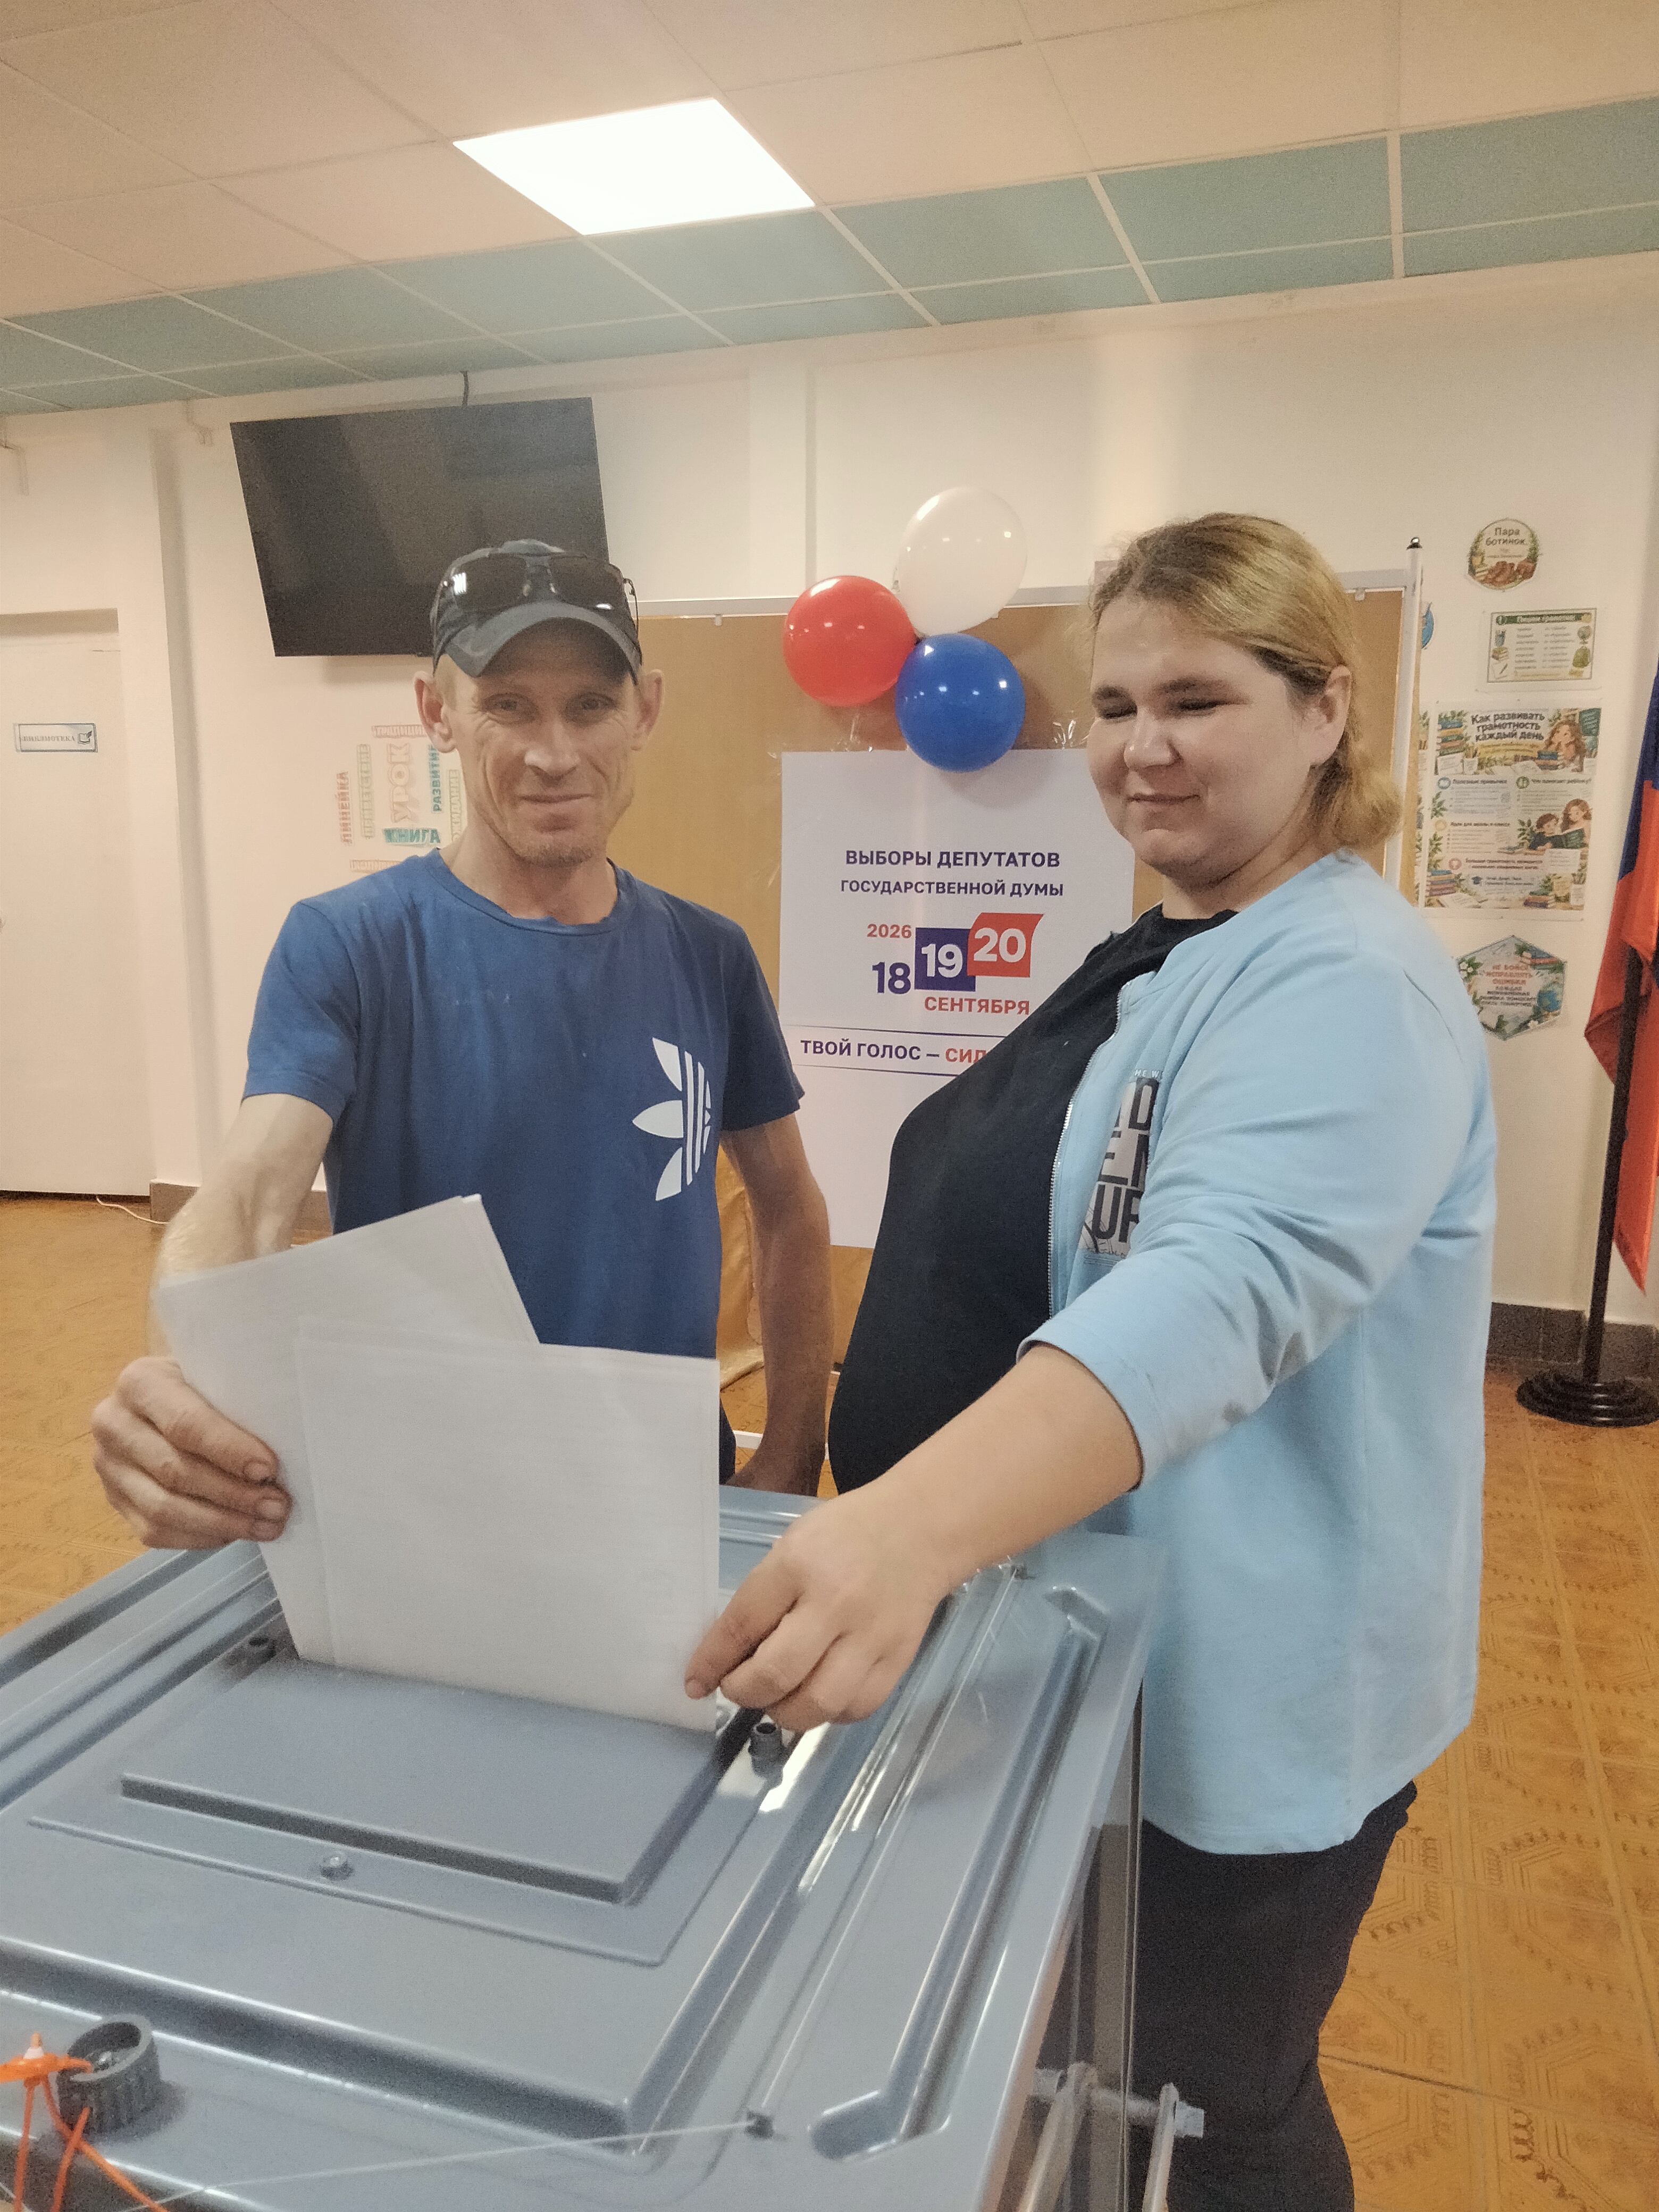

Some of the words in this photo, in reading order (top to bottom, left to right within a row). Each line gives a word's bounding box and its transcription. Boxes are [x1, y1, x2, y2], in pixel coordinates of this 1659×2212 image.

[1495, 527, 1520, 537] Пара
[1471, 715, 1490, 725] Как
[1493, 713, 1545, 722] развивать
[1477, 722, 1541, 732] грамотность
[1476, 731, 1517, 742] каждый
[1519, 732, 1544, 740] день
[387, 743, 412, 823] УРОК
[336, 771, 352, 844] ЛИНЕЙКА
[383, 828, 441, 844] КНИГА
[845, 850, 931, 866] ВЫБОРЫ
[937, 851, 1060, 868] ДЕПУТАТОВ
[841, 879, 1006, 895] ГОСУДАРСТВЕННОЙ
[1010, 883, 1063, 898] ДУМЫ
[867, 924, 912, 939] 2026
[872, 961, 911, 994] 18
[921, 943, 963, 978] 19
[973, 927, 1027, 963] 20
[924, 996, 1030, 1016] СЕНТЯБРЯ
[800, 1038, 851, 1057] ТВОЙ
[857, 1043, 921, 1061] ГОЛОС
